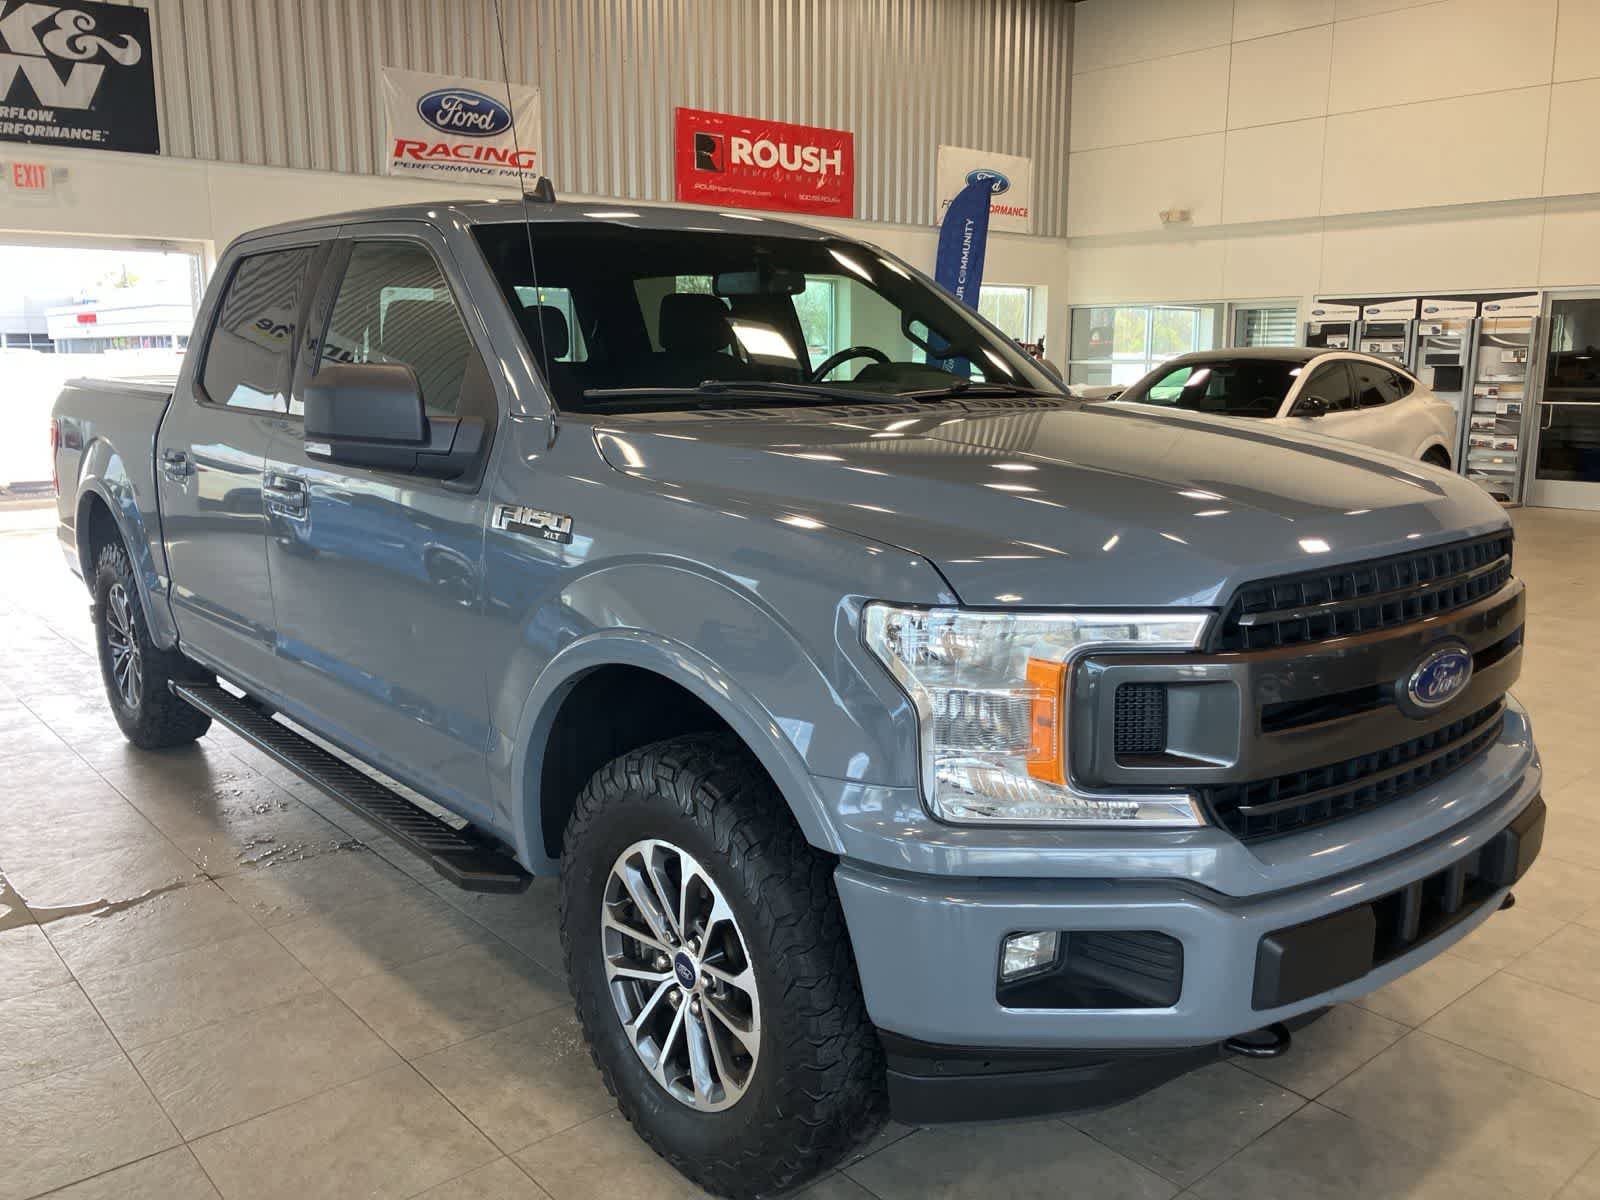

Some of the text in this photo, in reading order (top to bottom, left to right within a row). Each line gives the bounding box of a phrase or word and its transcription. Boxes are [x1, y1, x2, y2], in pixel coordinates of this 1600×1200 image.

[436, 95, 495, 130] Ford
[394, 138, 537, 169] RACING
[731, 136, 842, 176] ROUSH
[13, 163, 46, 190] EXIT
[393, 161, 537, 179] PERFORMANCE PARTS
[990, 204, 1029, 218] ORMANCE
[958, 218, 975, 284] COMMUNITY
[543, 530, 561, 541] XLT
[1428, 661, 1464, 697] Ford
